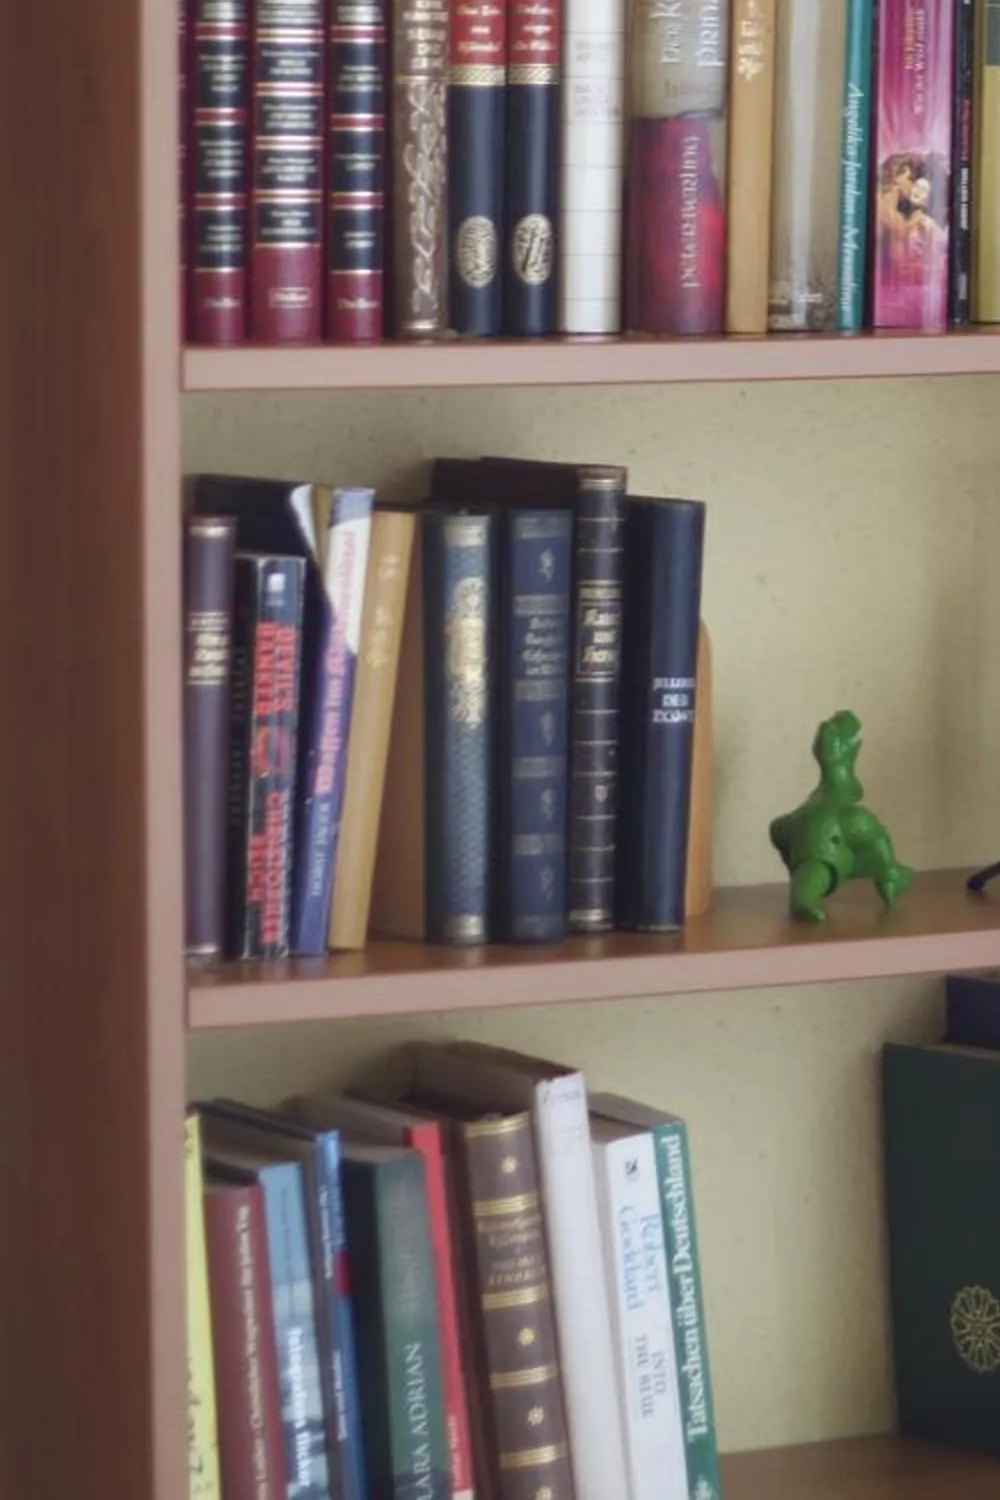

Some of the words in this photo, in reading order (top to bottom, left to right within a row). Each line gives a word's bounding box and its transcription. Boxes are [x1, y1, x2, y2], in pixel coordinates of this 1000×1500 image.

[254, 621, 276, 717] BANKER
[661, 1133, 695, 1274] Deutschland
[676, 1275, 700, 1327] über
[404, 1342, 430, 1435] ADRIAN
[683, 1326, 709, 1441] Tatsachen
